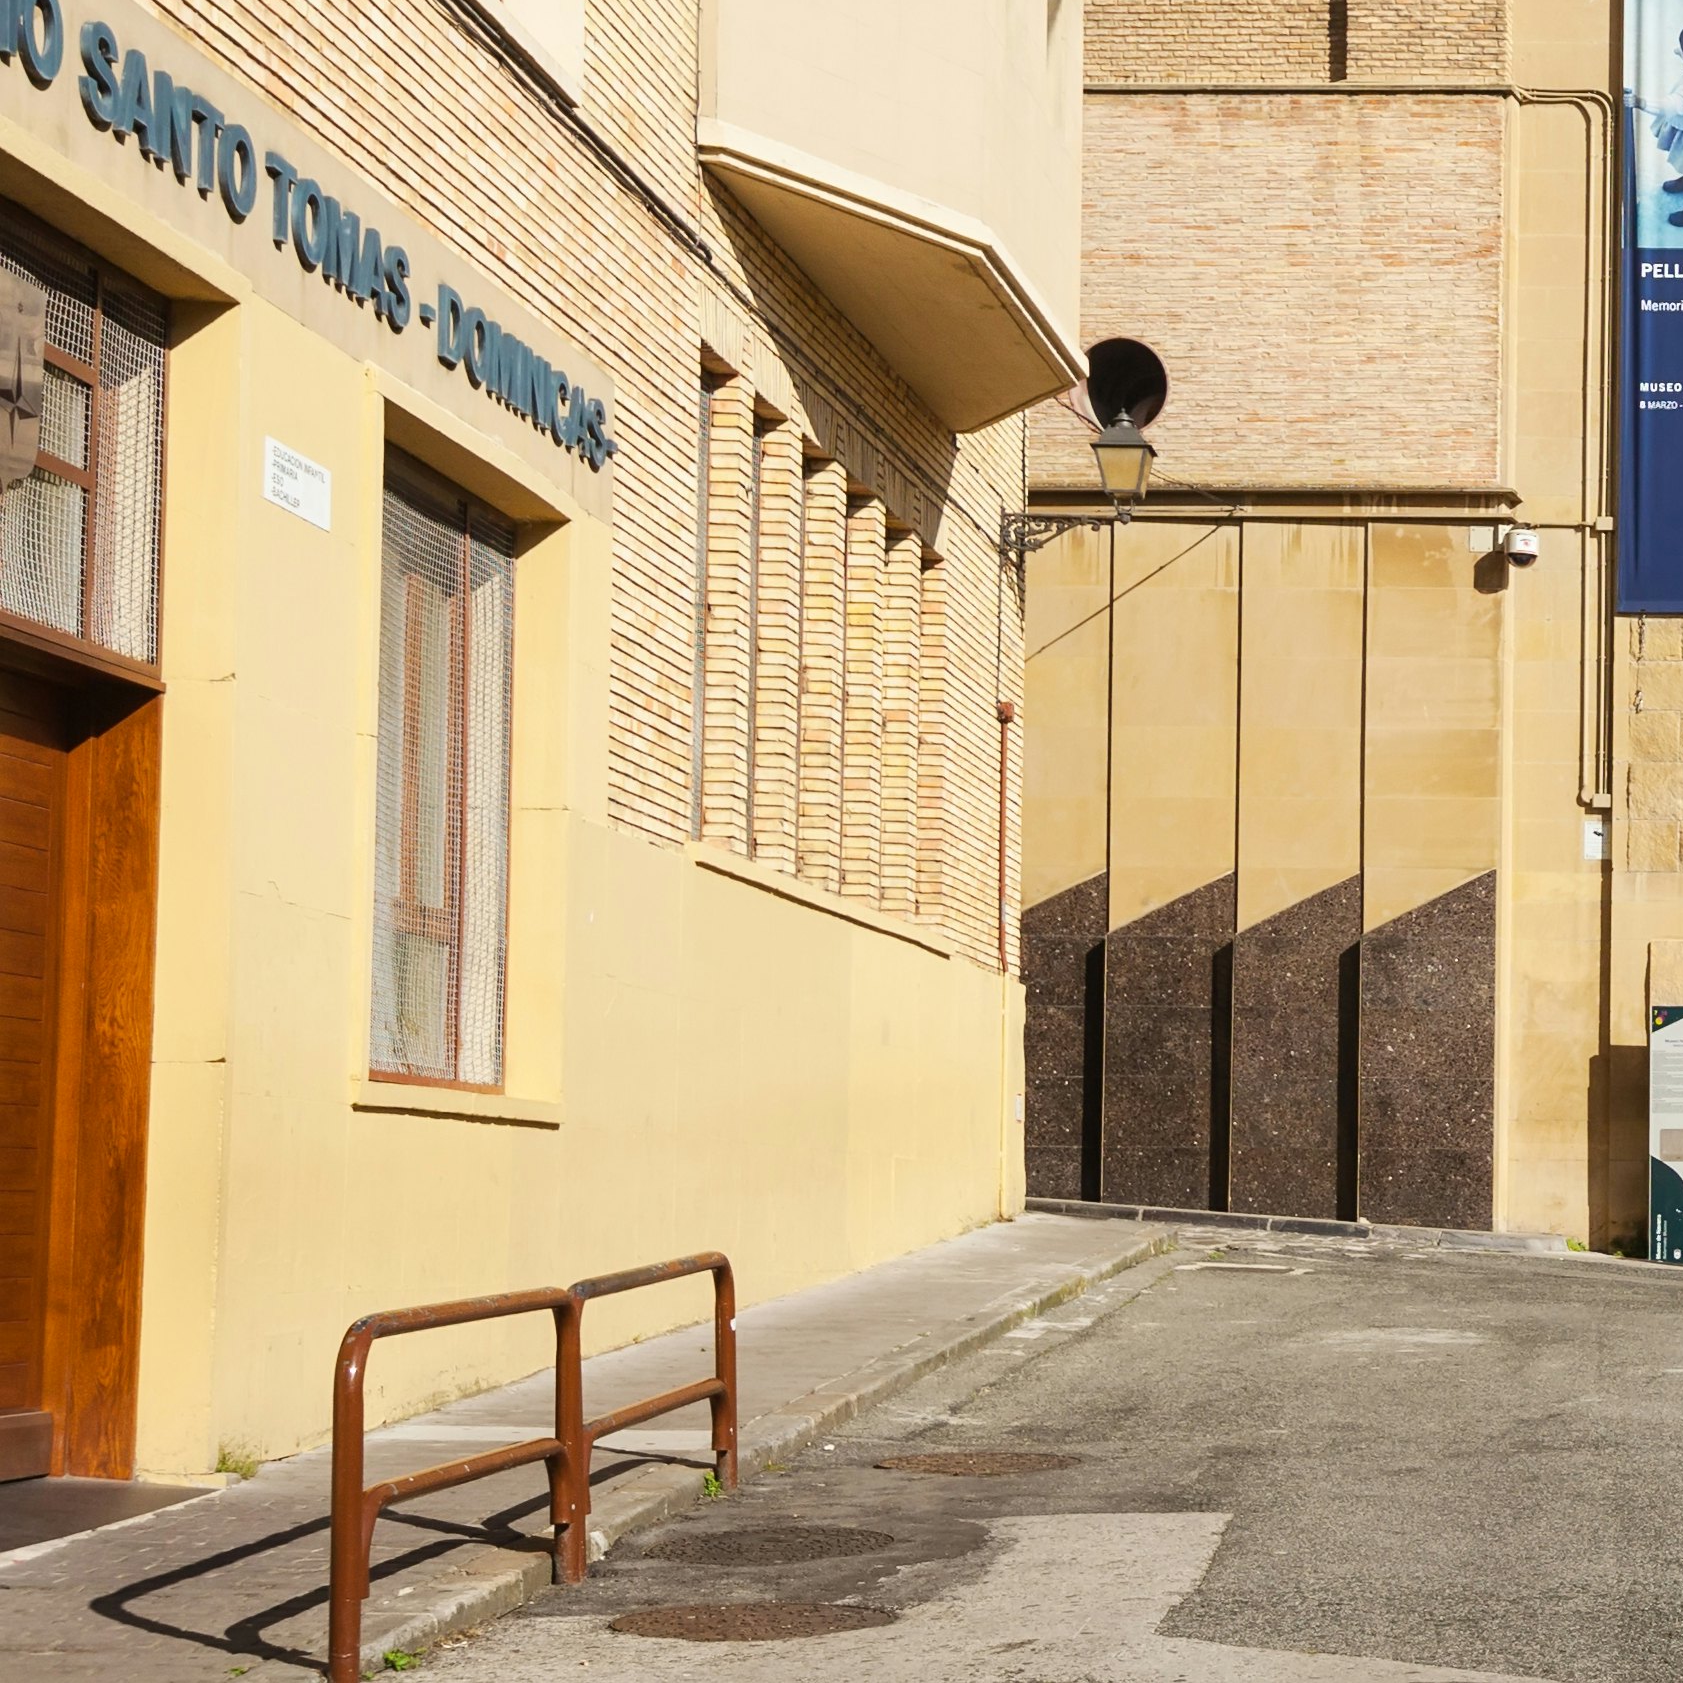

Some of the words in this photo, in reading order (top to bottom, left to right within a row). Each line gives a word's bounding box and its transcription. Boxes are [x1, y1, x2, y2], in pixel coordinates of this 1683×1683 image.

[78, 20, 257, 224] SANTO
[265, 151, 411, 334] TOMAS
[1639, 382, 1682, 393] MUSEO
[1647, 401, 1678, 410] MARZO
